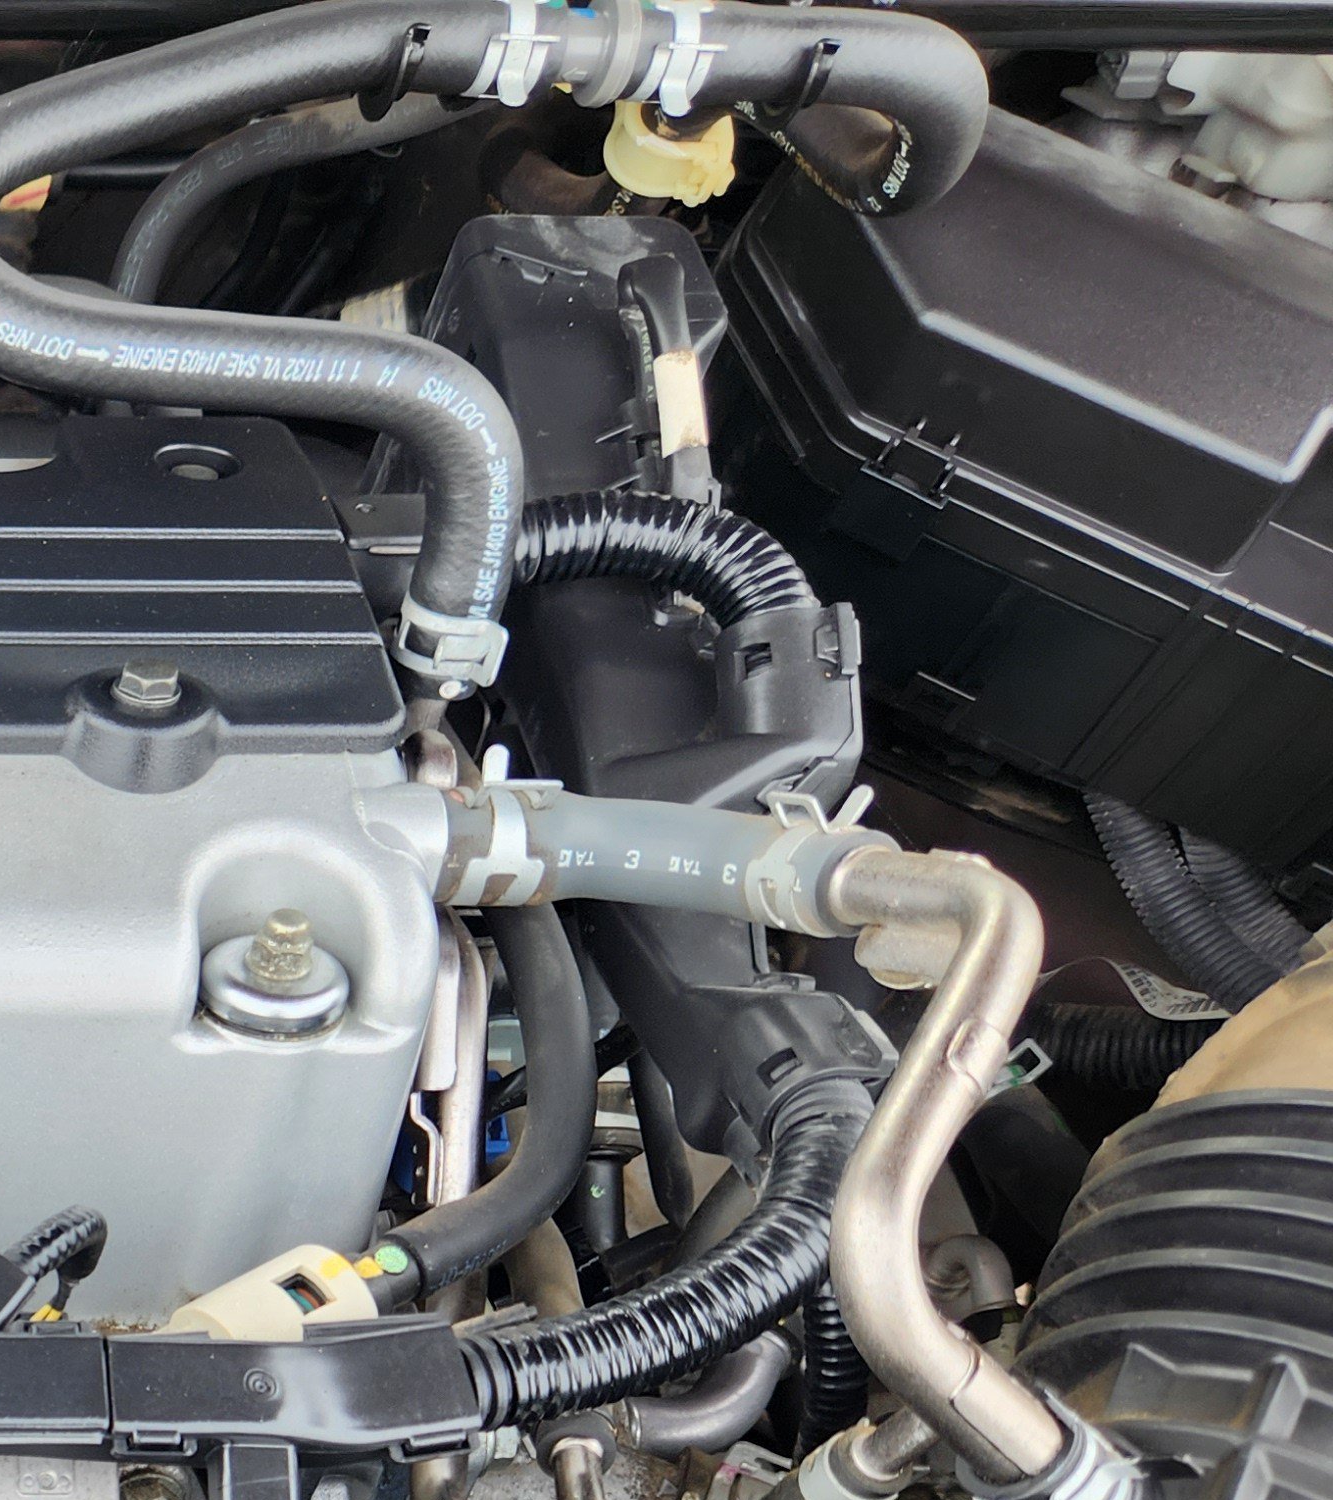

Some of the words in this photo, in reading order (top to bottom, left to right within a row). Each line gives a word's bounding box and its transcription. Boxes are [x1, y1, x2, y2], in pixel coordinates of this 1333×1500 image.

[31, 330, 76, 361] DOT
[111, 344, 179, 371] ENGINE
[178, 346, 225, 376] J1403
[223, 352, 261, 378] SAE
[262, 355, 282, 379] VL
[417, 375, 459, 410] NRS
[448, 395, 486, 431] DOT
[486, 456, 509, 521] ENGINE
[481, 521, 508, 569] J1403
[472, 566, 499, 602] SAE
